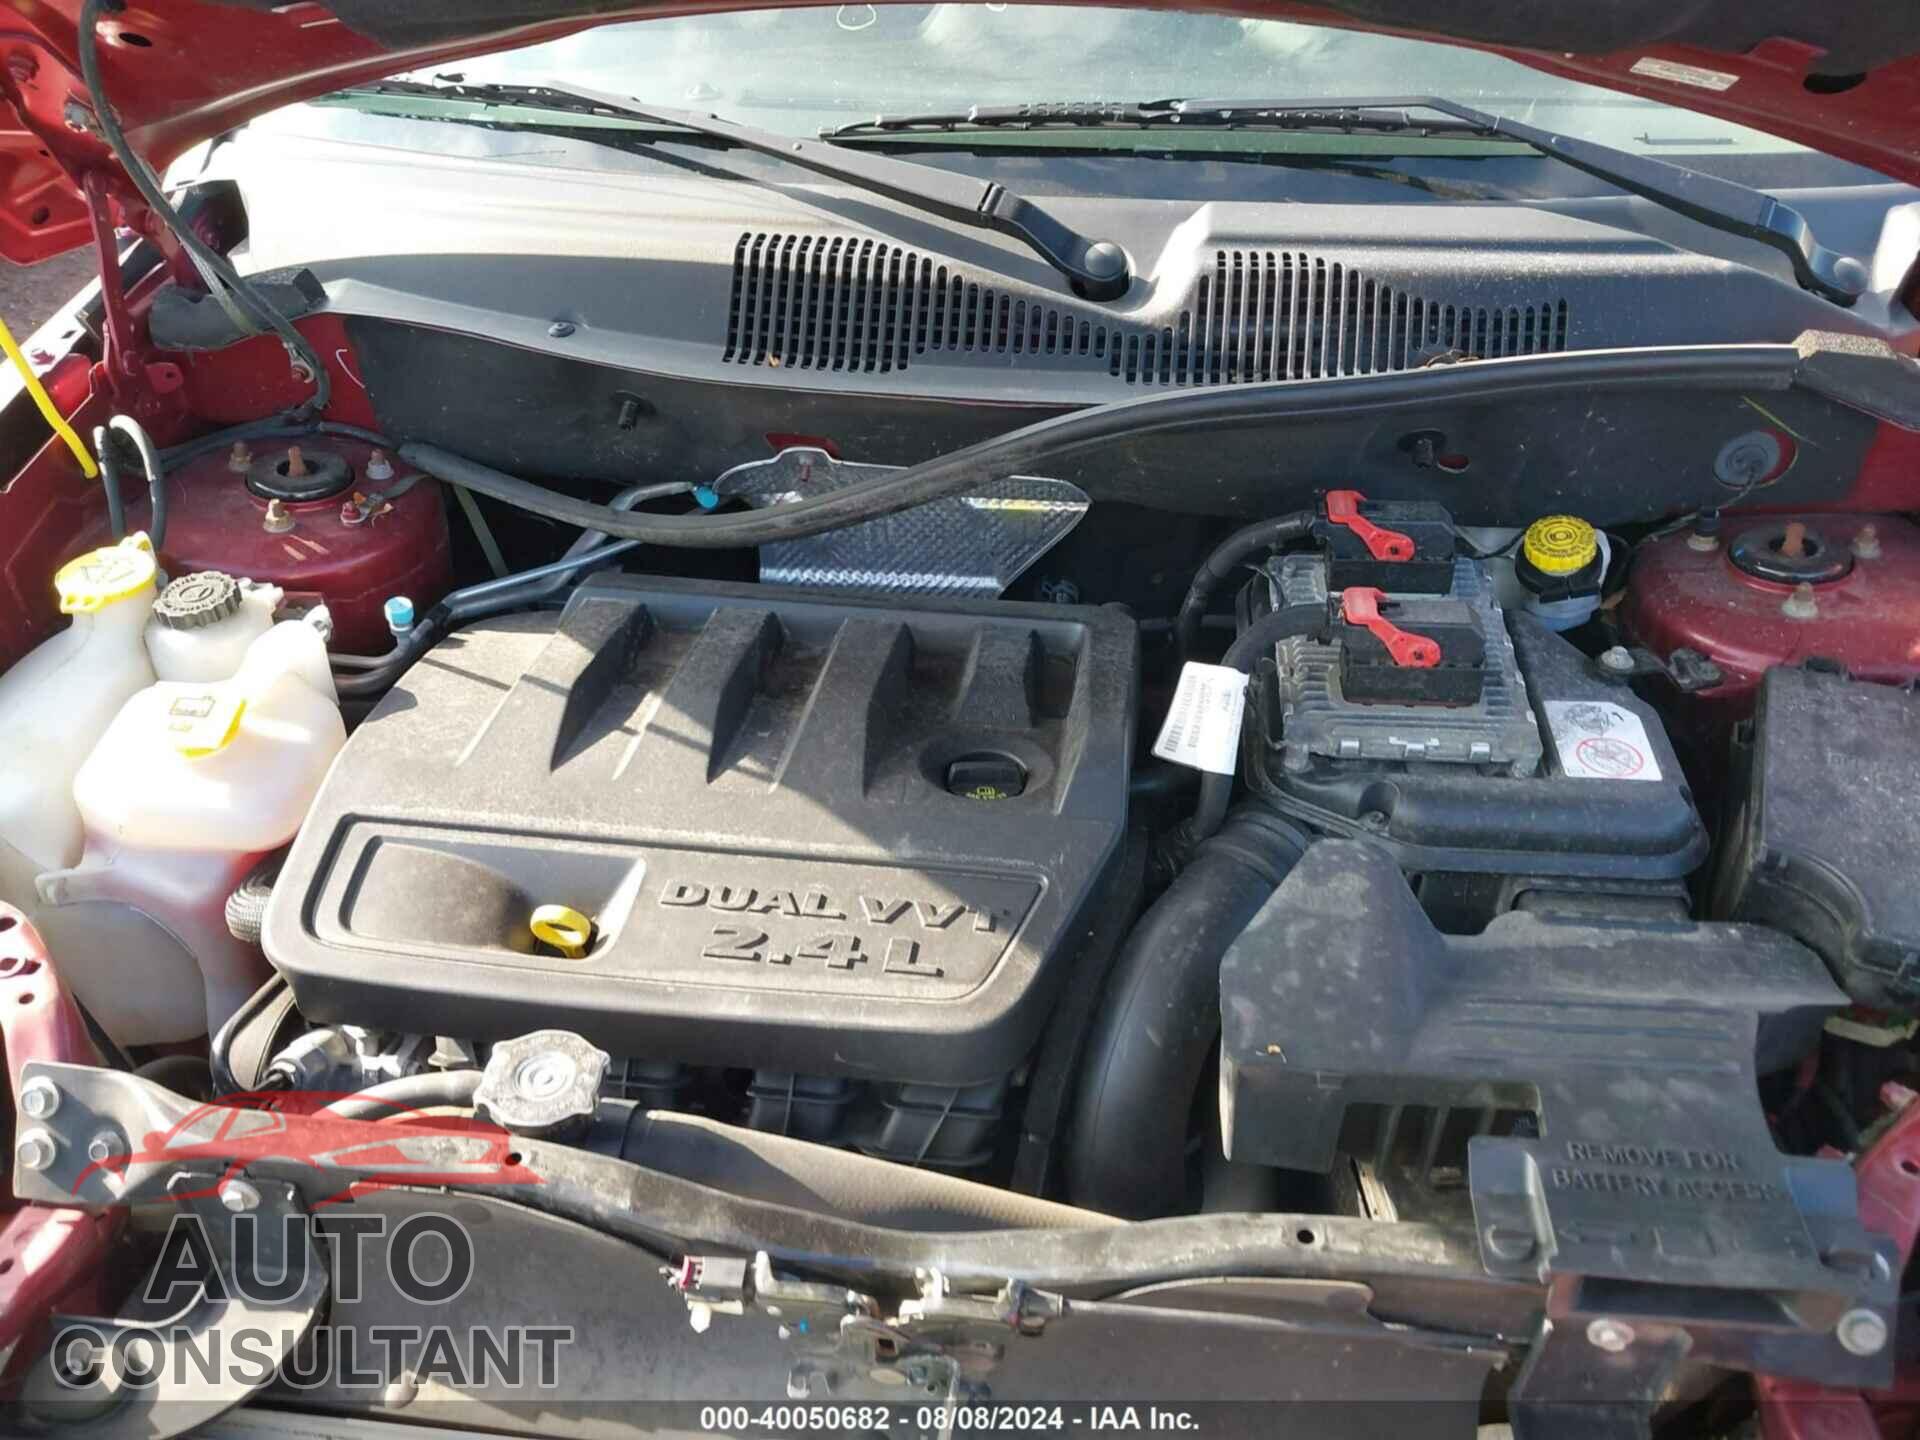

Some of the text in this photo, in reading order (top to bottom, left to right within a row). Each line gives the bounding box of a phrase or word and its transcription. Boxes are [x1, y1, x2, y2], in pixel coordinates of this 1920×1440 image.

[660, 881, 847, 921] DUAL
[1566, 1140, 1740, 1171] REMOVE FOR
[1551, 1167, 1661, 1196] BATTERY
